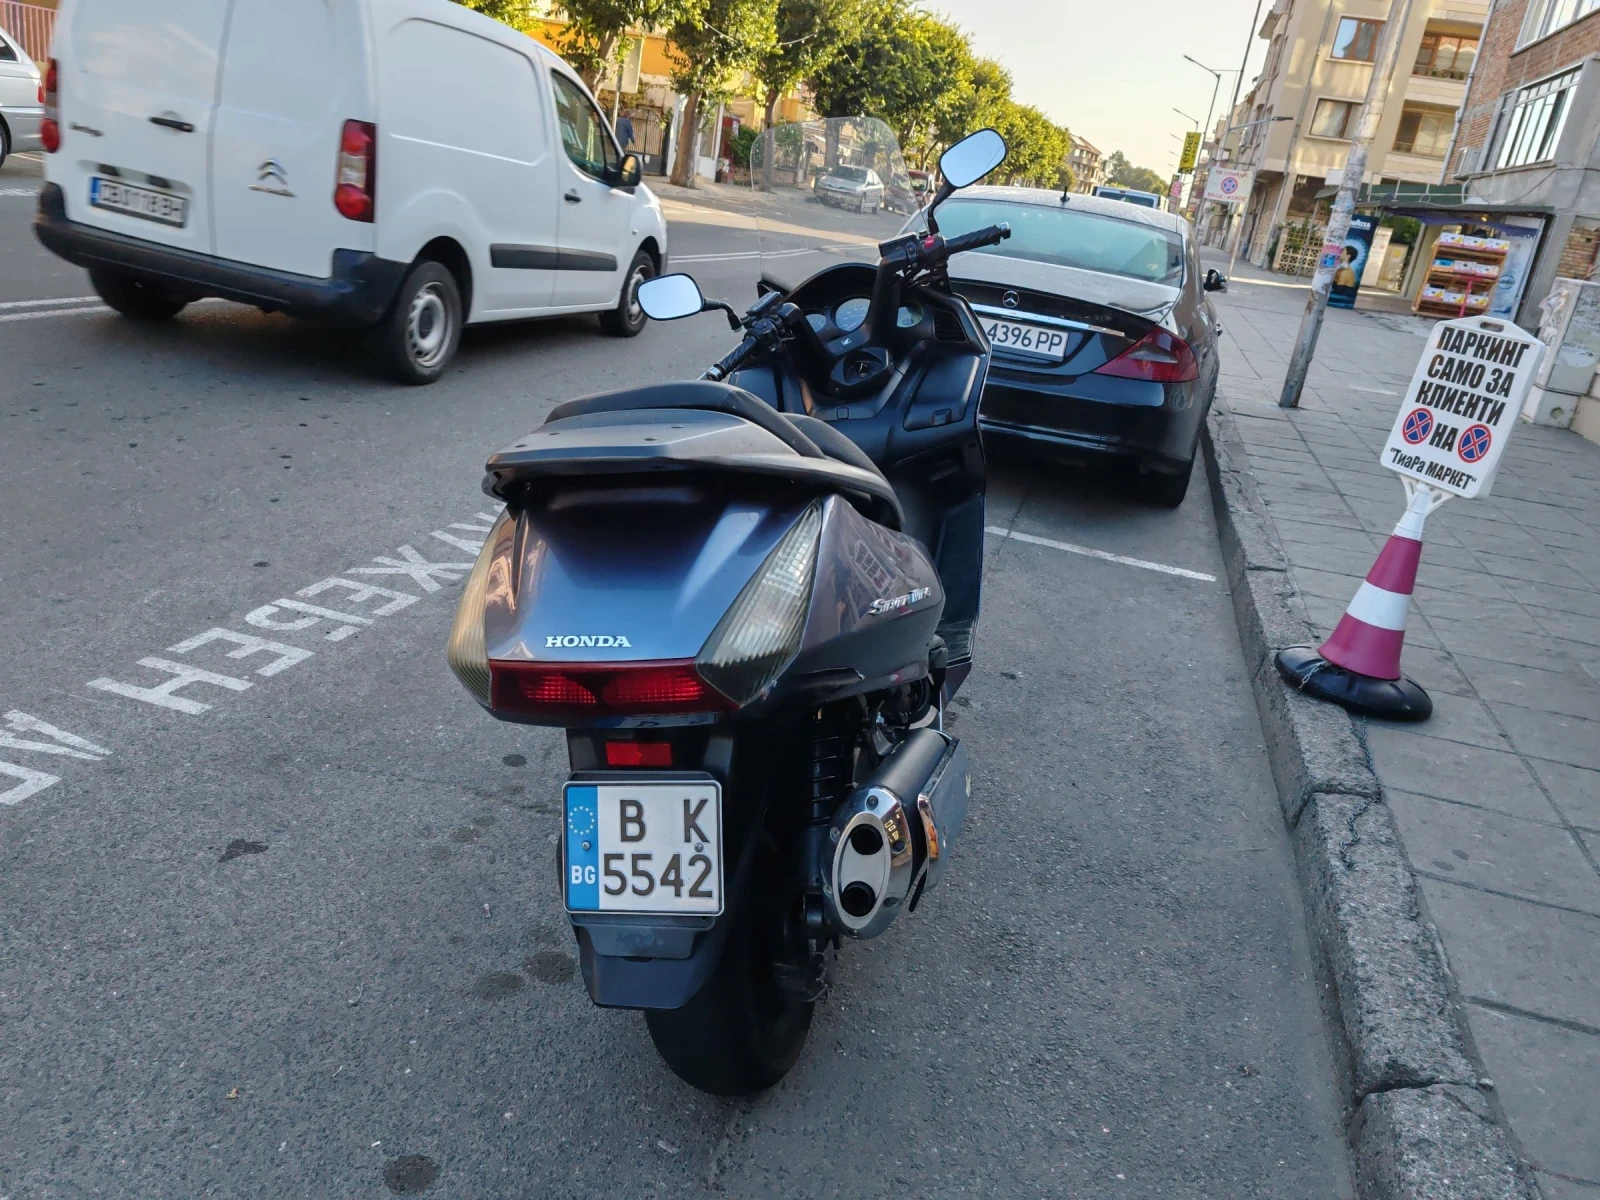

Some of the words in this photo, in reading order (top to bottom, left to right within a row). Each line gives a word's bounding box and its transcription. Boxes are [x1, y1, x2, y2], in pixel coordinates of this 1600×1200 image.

[987, 323, 1032, 348] 4396
[1035, 331, 1063, 352] PP
[1436, 326, 1530, 368] ПАРКИНГ
[1427, 353, 1487, 389] САМО
[1485, 367, 1516, 398] ЗА
[1415, 380, 1507, 427] КЛИЕНТИ
[1428, 423, 1459, 452] НА
[545, 635, 632, 648] HONDA
[619, 799, 646, 843] B
[683, 798, 711, 843] K
[571, 866, 596, 885] BG
[603, 853, 713, 898] 5542
